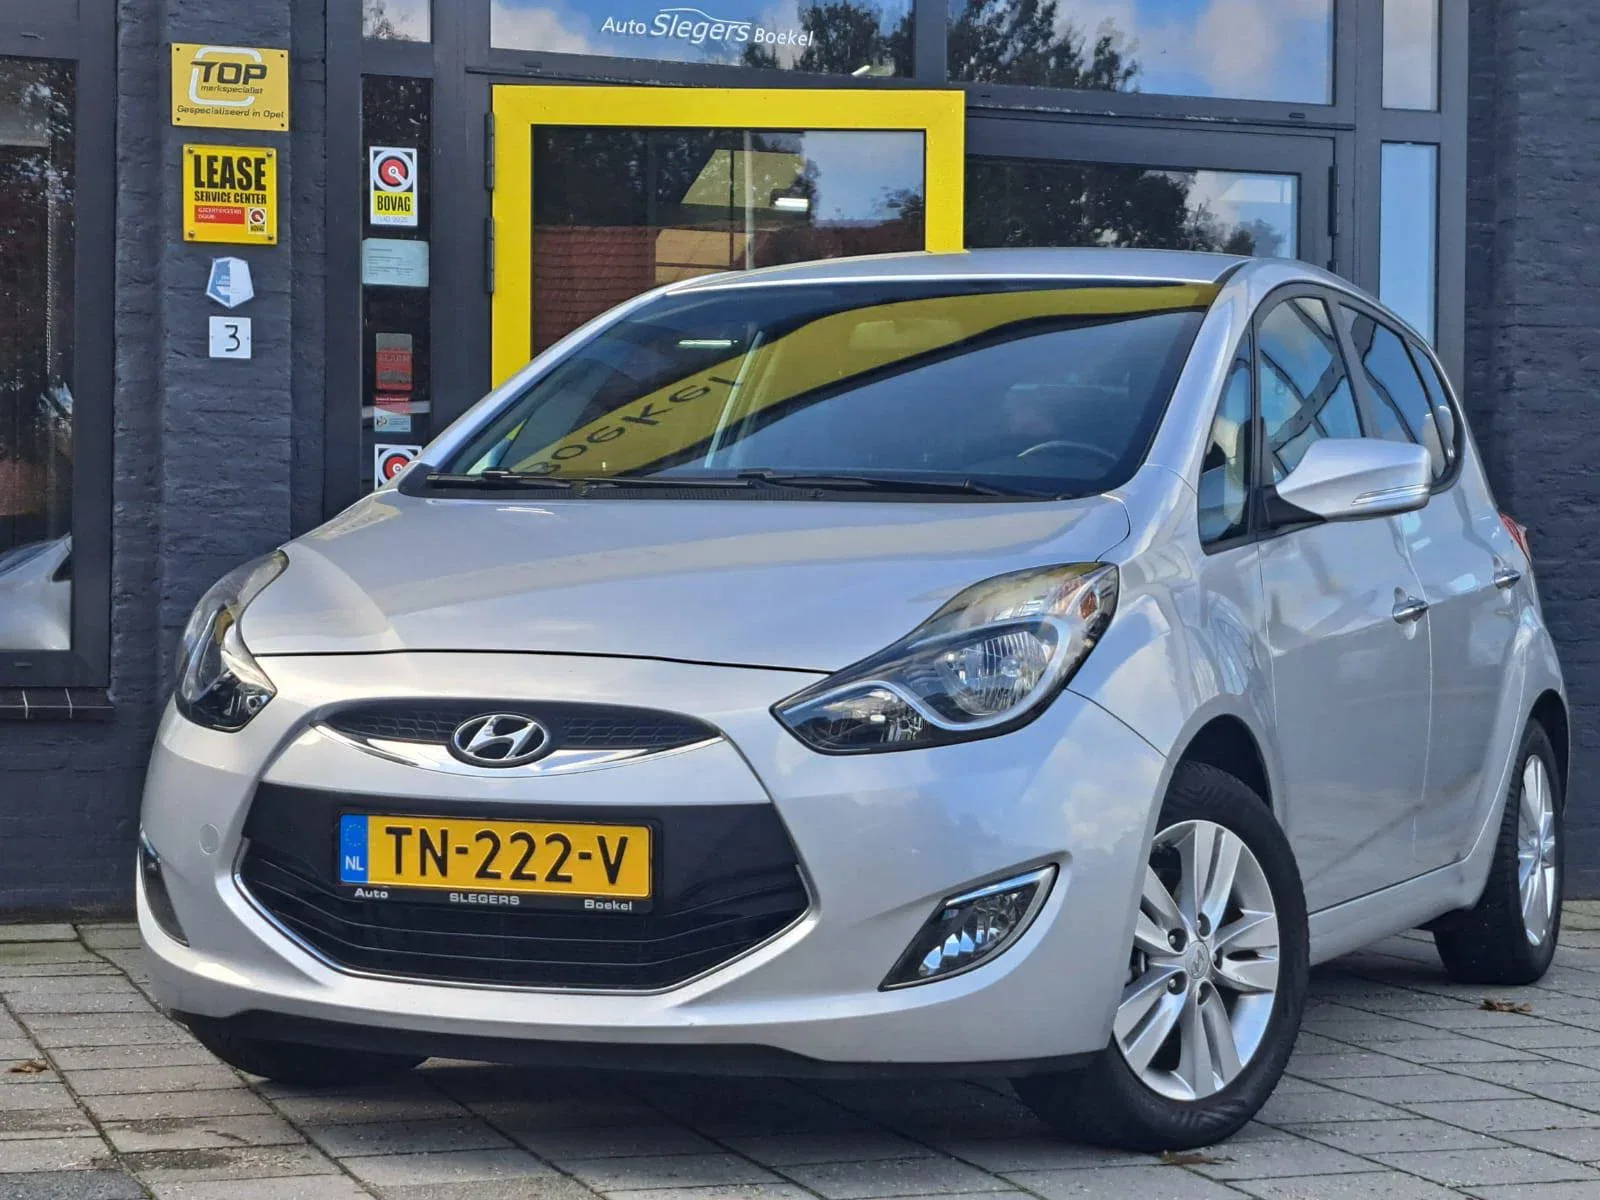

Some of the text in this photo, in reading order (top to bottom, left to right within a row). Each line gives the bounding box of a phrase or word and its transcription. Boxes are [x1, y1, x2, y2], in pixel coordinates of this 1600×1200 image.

[601, 13, 814, 47] Auto Slegers Boekel
[190, 61, 268, 85] TOP
[201, 84, 263, 95] merkspecialist
[177, 105, 250, 117] Gespecialiseerd
[263, 109, 285, 120] Opel
[194, 154, 267, 191] LEASE
[194, 190, 267, 205] SERVICE CENTER
[377, 194, 411, 212] BOVAG
[224, 324, 241, 352] 3
[345, 855, 365, 872] NL
[385, 826, 629, 885] TN-222-V
[354, 888, 633, 912] Auto SLEGERS Boekel
